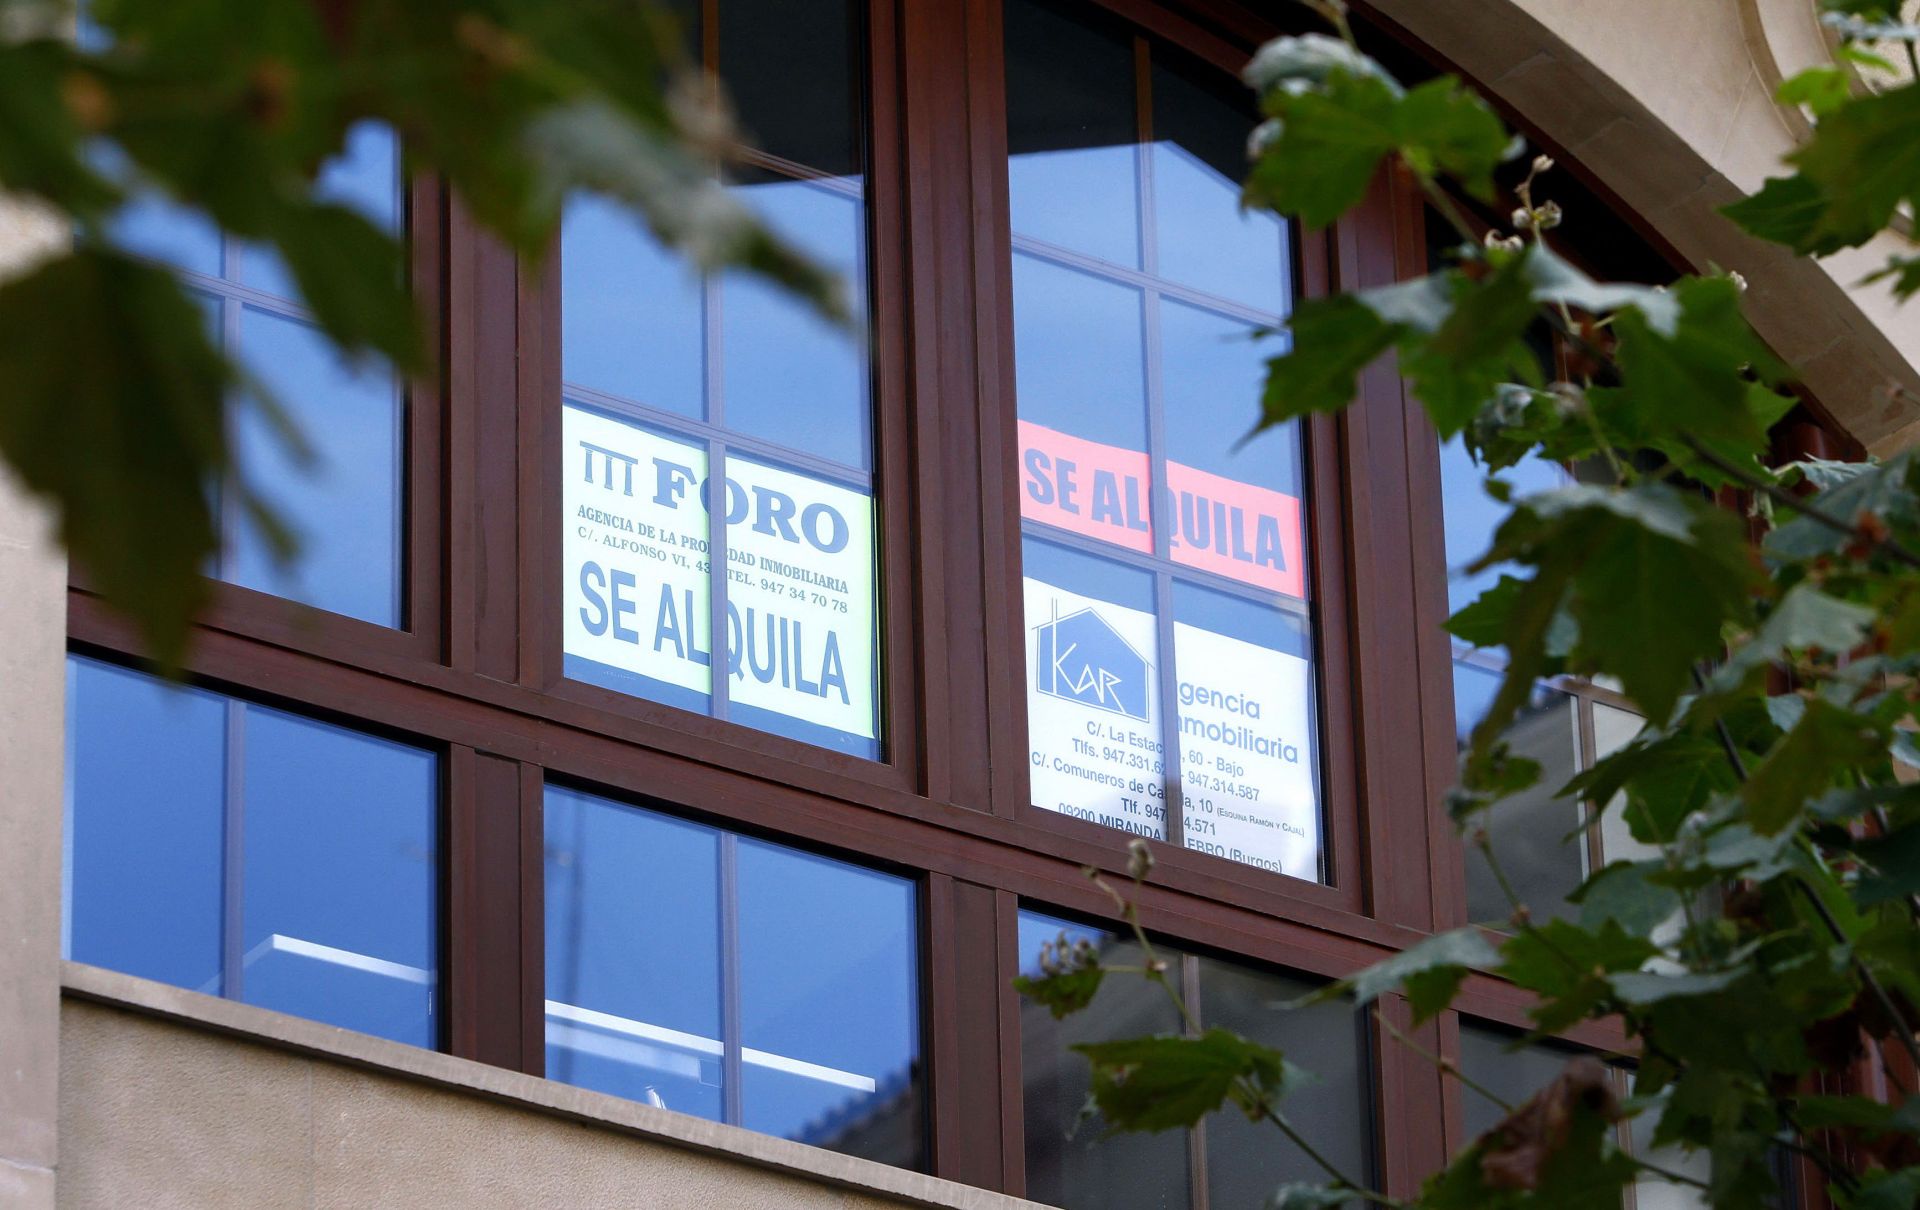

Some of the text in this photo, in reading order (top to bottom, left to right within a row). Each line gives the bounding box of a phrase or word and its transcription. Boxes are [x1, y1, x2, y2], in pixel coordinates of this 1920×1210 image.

[578, 504, 848, 593] AGENCIA DE LA PRODAD INMOBILIARIA
[653, 457, 850, 553] FORO
[1024, 448, 1287, 572] SE ALQUILA
[578, 526, 598, 542] C/.
[603, 534, 667, 561] ALFONSO
[727, 568, 755, 586] TEL.
[761, 578, 784, 594] 947
[790, 587, 806, 601] 34
[811, 593, 827, 607] 70
[832, 600, 848, 613] 78
[580, 561, 850, 705] SE ALQUILA
[1051, 618, 1126, 713] KAR
[1032, 752, 1049, 768] C/.
[1053, 757, 1125, 789] Comuneros
[1129, 779, 1144, 794] de
[1200, 798, 1213, 814] 10
[1072, 738, 1099, 758] Tlfs.
[1188, 770, 1260, 801] 947.314.587
[1086, 721, 1105, 738] C/.
[1110, 726, 1124, 743] La
[1189, 750, 1203, 766] 60
[1217, 757, 1244, 778] Bajo
[1099, 813, 1161, 840] MIRANDA
[1229, 847, 1282, 873] (Burgos)
[1121, 798, 1141, 815] Tlf.
